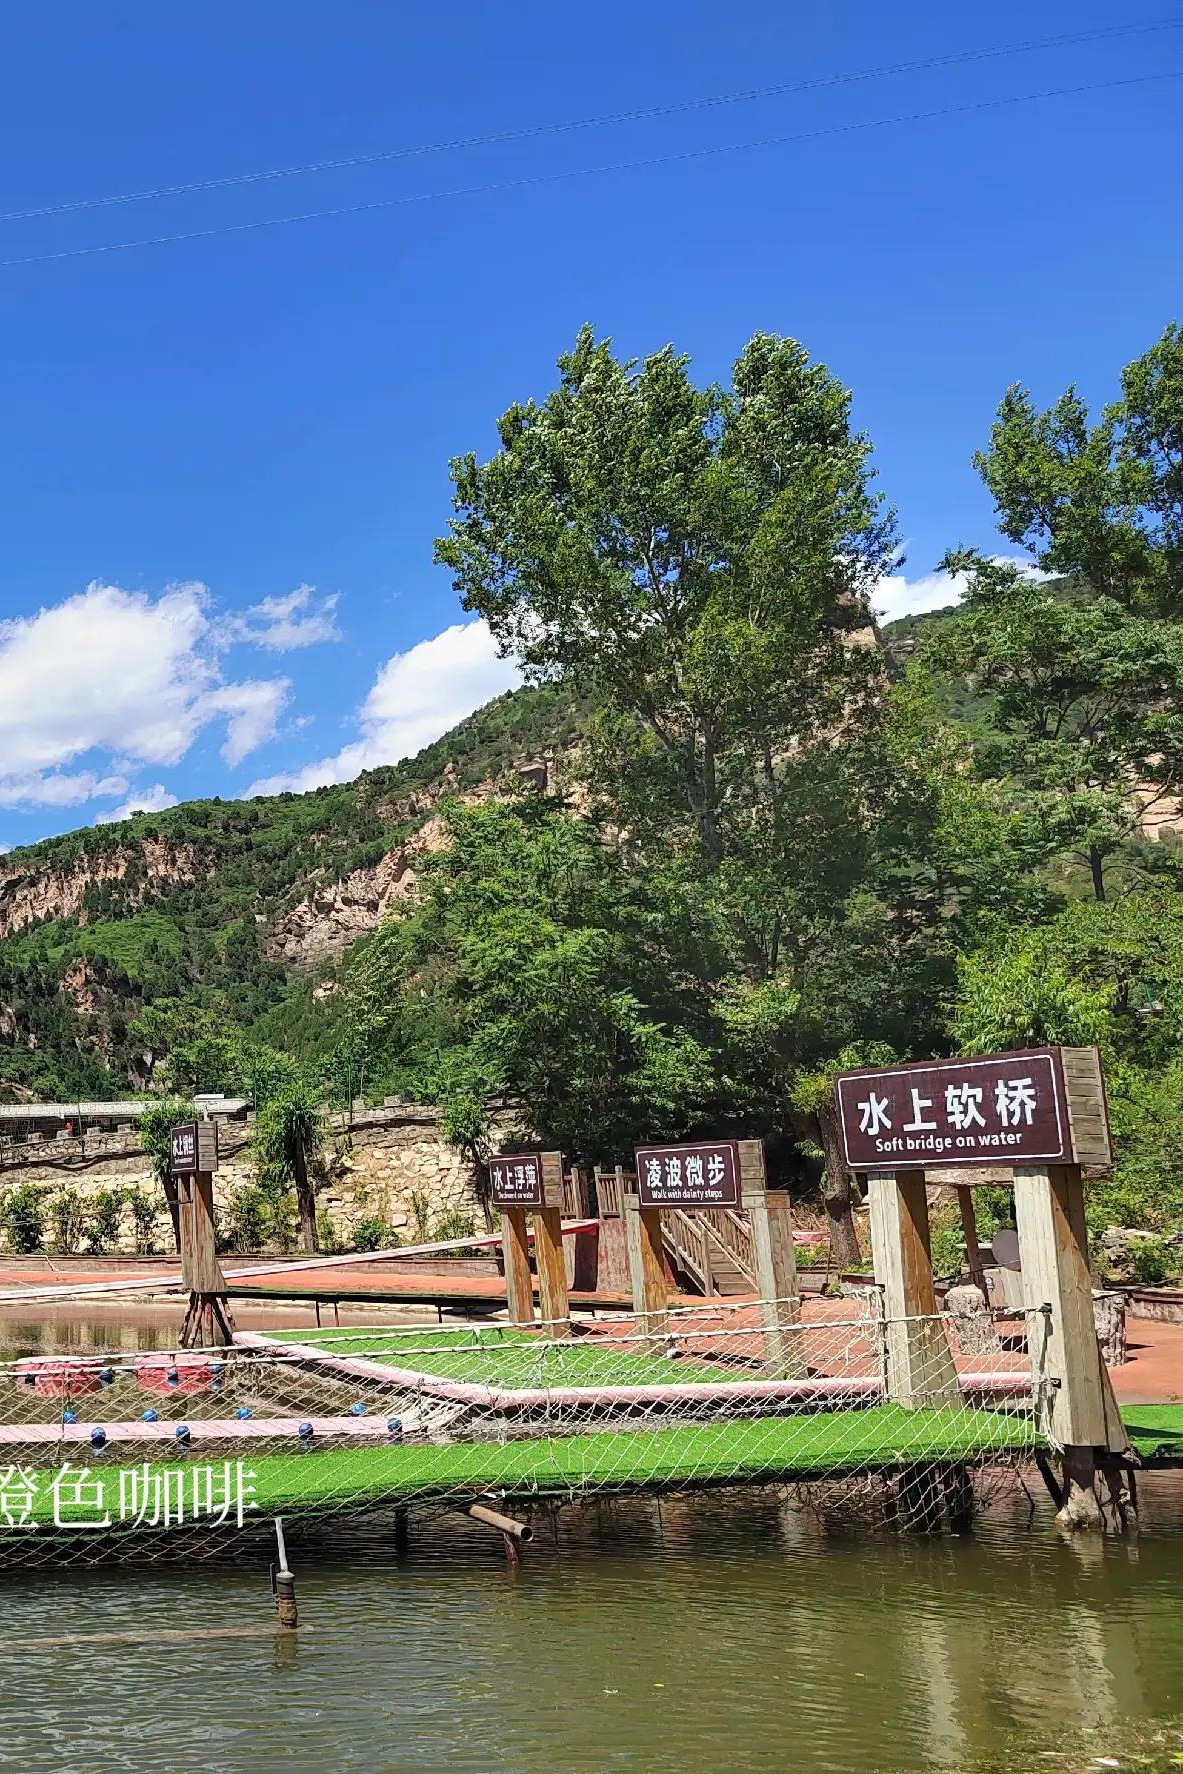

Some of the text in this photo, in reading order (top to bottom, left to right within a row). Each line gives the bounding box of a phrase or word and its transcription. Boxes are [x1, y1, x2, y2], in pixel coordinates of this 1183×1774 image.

[857, 1078, 1037, 1135] 水上软桥
[875, 1133, 1023, 1152] Soft bridge on water
[645, 1153, 725, 1188] 凌波微步
[651, 1189, 723, 1200] Walk with dainty steps
